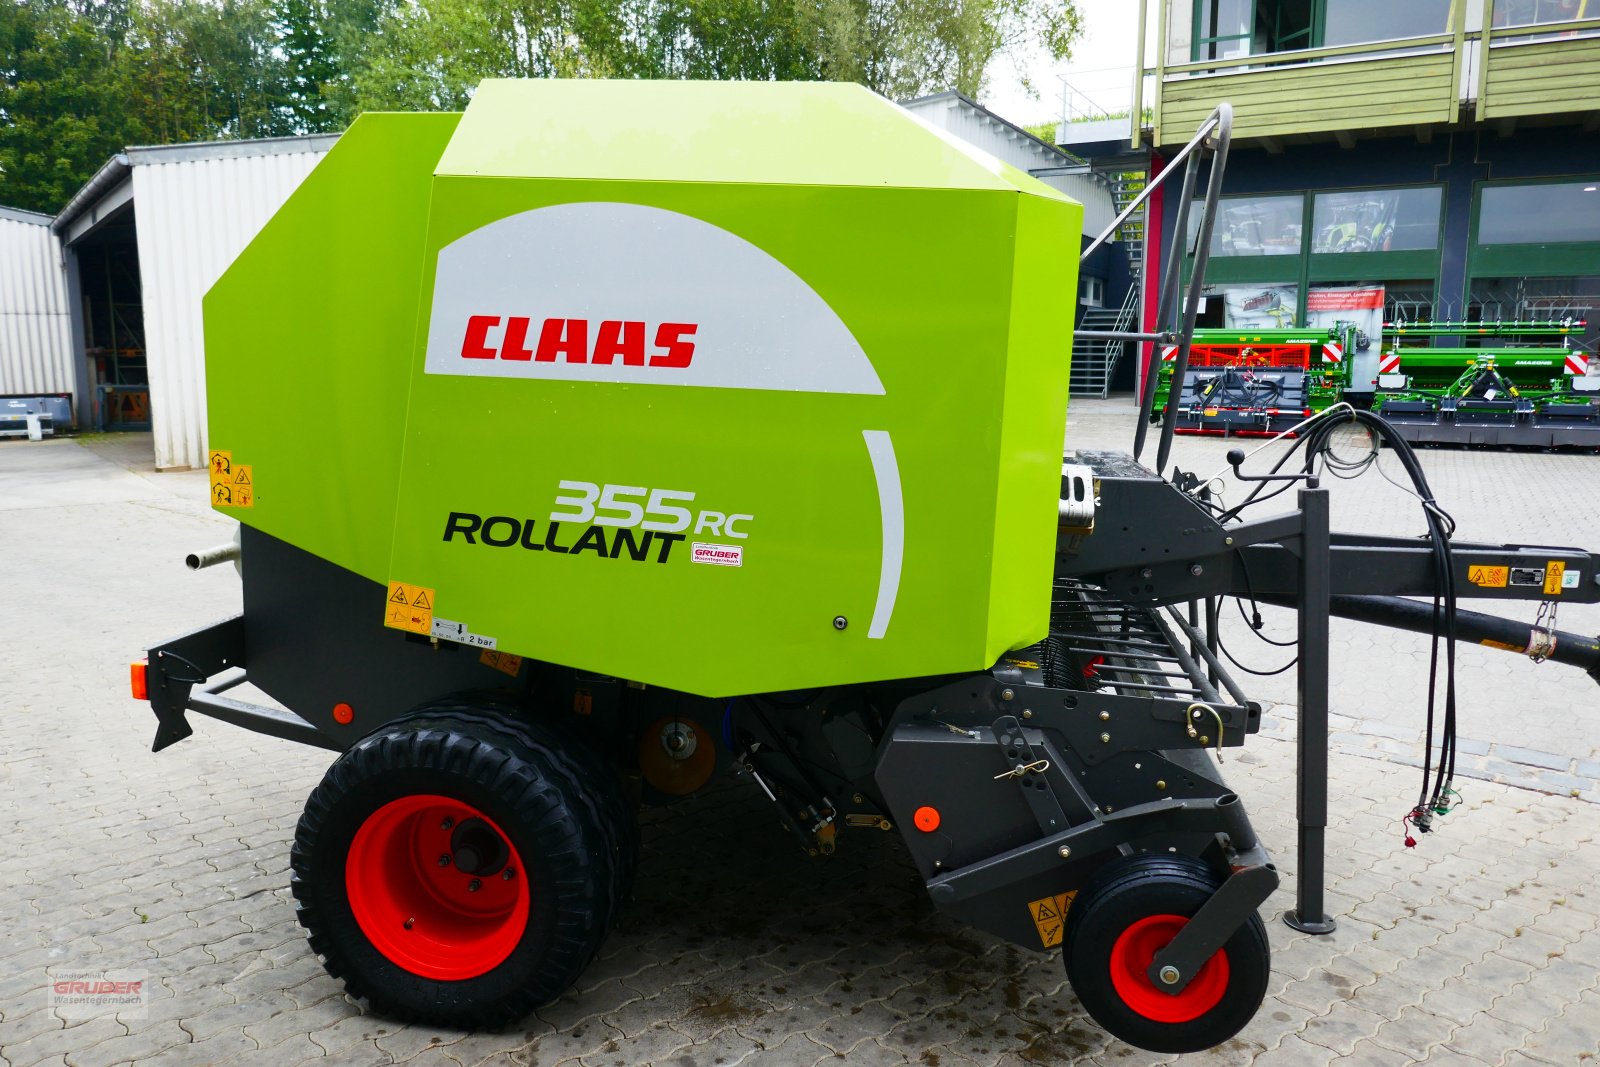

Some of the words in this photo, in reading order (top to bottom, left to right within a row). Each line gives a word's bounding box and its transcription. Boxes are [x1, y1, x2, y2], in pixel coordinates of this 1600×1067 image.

[461, 316, 697, 368] CLAAS
[549, 480, 695, 532] 355
[693, 510, 754, 539] RC
[443, 512, 686, 563] ROLLANT
[695, 549, 739, 559] GRUBER
[469, 635, 475, 643] 2
[477, 637, 493, 646] bar
